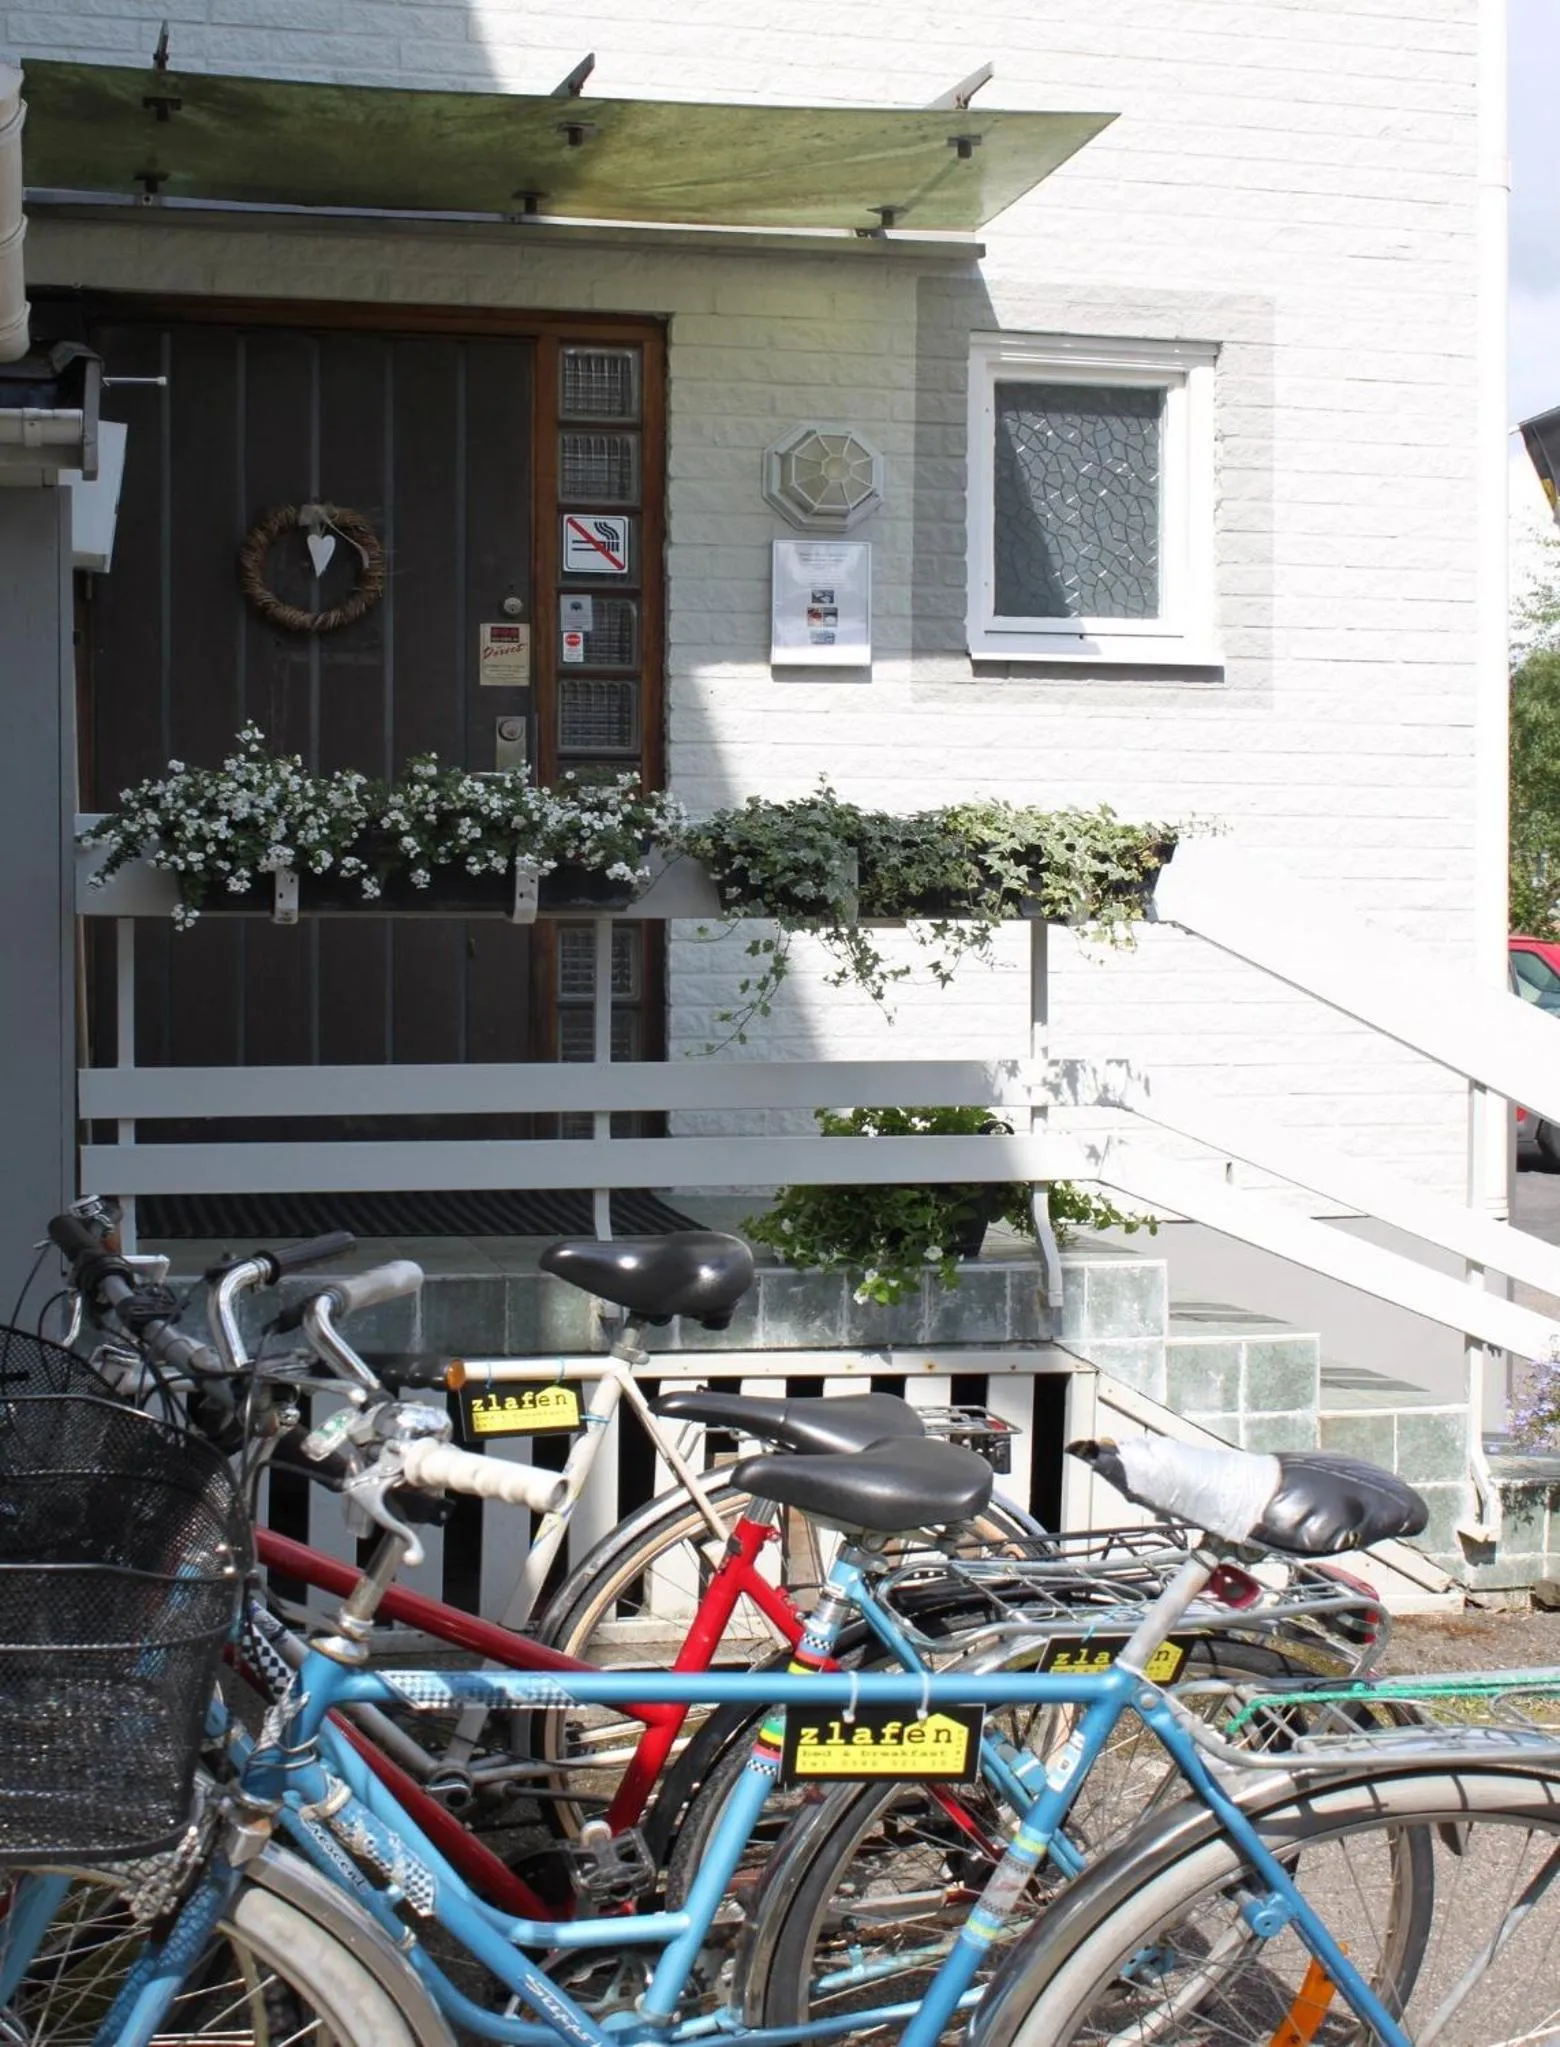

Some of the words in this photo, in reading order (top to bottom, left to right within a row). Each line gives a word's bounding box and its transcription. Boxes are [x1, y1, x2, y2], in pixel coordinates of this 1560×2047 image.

[471, 1391, 567, 1412] zlafen
[1055, 1648, 1169, 1665] zlan
[799, 1721, 952, 1745] zlafen
[860, 1750, 946, 1758] breakfast
